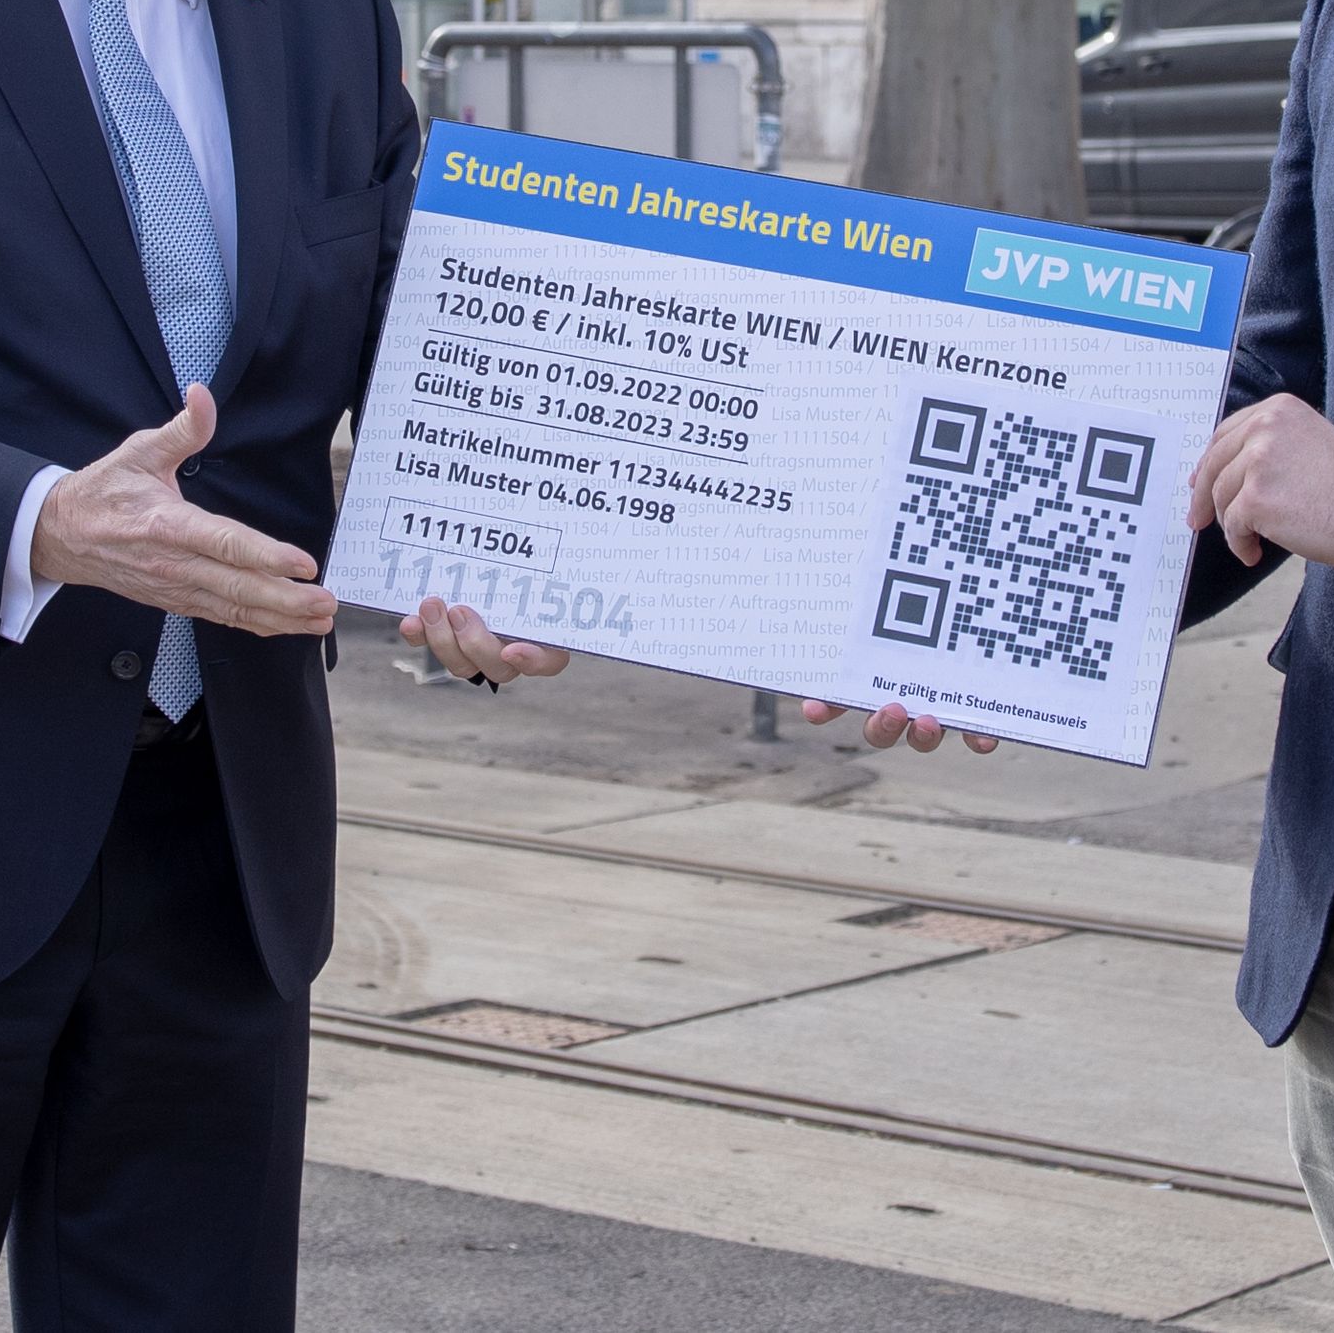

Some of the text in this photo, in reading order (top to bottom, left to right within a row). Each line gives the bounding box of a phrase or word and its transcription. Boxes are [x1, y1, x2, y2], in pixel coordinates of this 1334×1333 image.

[443, 151, 933, 262] Studenten Jahreskarte Wien
[421, 245, 548, 262] Auftragsnummer
[554, 246, 626, 258] 11111504
[545, 266, 677, 283] Auftragsnummer
[682, 268, 757, 281] 11111504
[980, 247, 1196, 313] JVP WIEN
[791, 290, 866, 304] 11111504
[436, 291, 748, 368] 120,00 € / inkl. 10% USt
[440, 257, 1066, 389] Studenten Jahreskarte WIEN / WIEN Kernzone
[887, 313, 964, 327] 11111504
[987, 313, 1016, 328] Lisa
[1022, 338, 1100, 351] 11111504
[1124, 338, 1154, 352] Lisa
[787, 360, 863, 374] 11111504
[1137, 362, 1215, 376] 11111504
[422, 339, 758, 419] Gültig von 01.09.2022 00:00
[414, 371, 748, 451] Gültig bis 31.08.2023 23:59
[772, 409, 801, 421] Lisa
[805, 409, 860, 422] Muster
[784, 431, 859, 445] 11111504
[402, 419, 792, 511] Matrikelnummer 112344442235
[637, 452, 664, 466] Lisa
[395, 451, 675, 523] Lisa Muster 04.06.1998
[802, 478, 857, 492] Muster
[403, 513, 533, 558] 11111504
[631, 523, 661, 537] Lisa
[665, 524, 718, 538] Muster
[734, 525, 869, 542] Auftragsnummer
[664, 548, 741, 562] 11111504
[763, 549, 792, 563] Lisa
[796, 550, 852, 564] Muster
[567, 568, 620, 583] Muster
[635, 569, 769, 585] Auftragsnummer
[776, 572, 851, 587] 11111504
[627, 592, 655, 607] Lisa
[661, 593, 715, 608] Muster
[730, 594, 852, 613] Auftragsnumm
[661, 617, 735, 633] 11111504
[759, 618, 788, 634] Lisa
[793, 619, 847, 635] Muster
[630, 640, 764, 657] Auftragsnummer
[872, 676, 1087, 729] Nur gültig mit Studentenausweis
